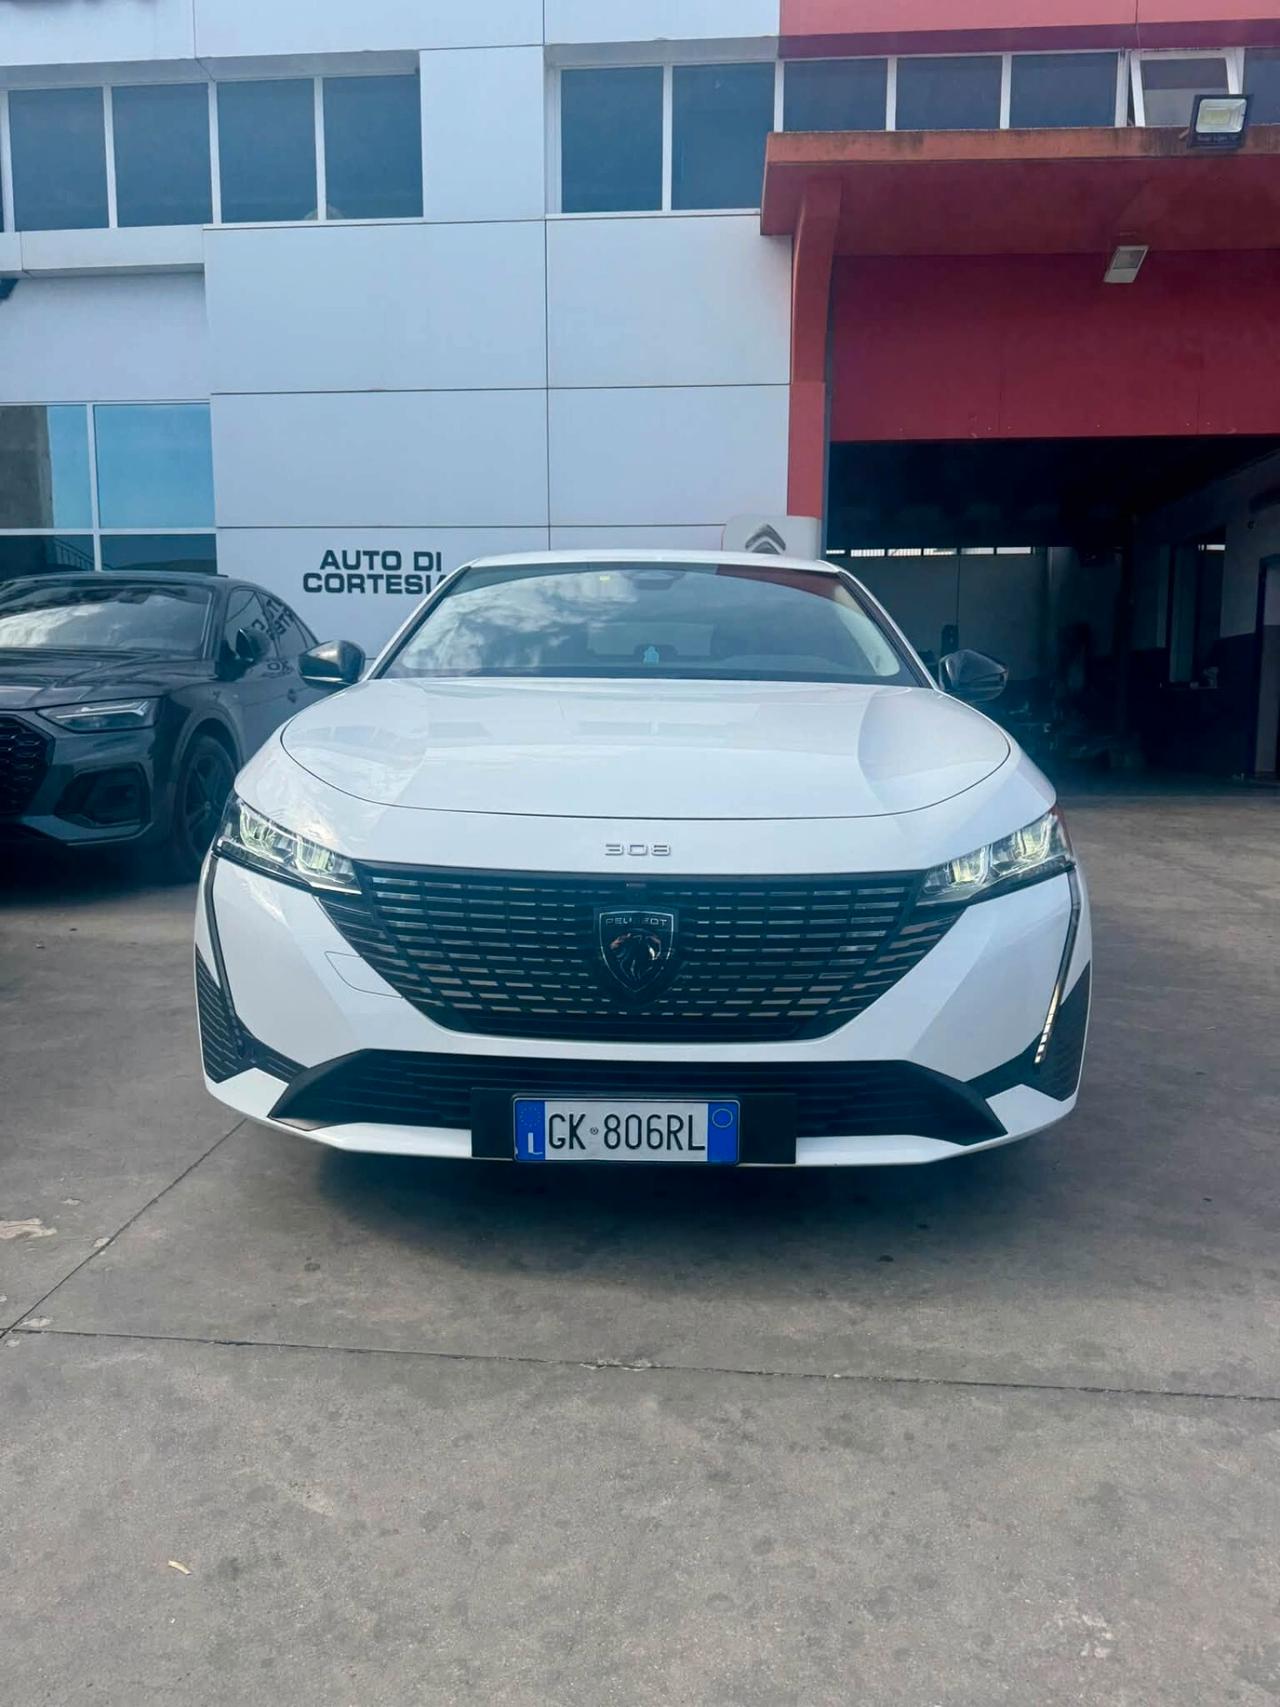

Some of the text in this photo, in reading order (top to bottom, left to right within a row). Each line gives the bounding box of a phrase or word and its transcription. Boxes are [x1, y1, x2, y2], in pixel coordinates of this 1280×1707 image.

[319, 549, 442, 572] AUTO DI
[604, 843, 671, 857] 308
[605, 916, 668, 927] PEUEOT
[548, 1113, 706, 1151] GK 806RL
